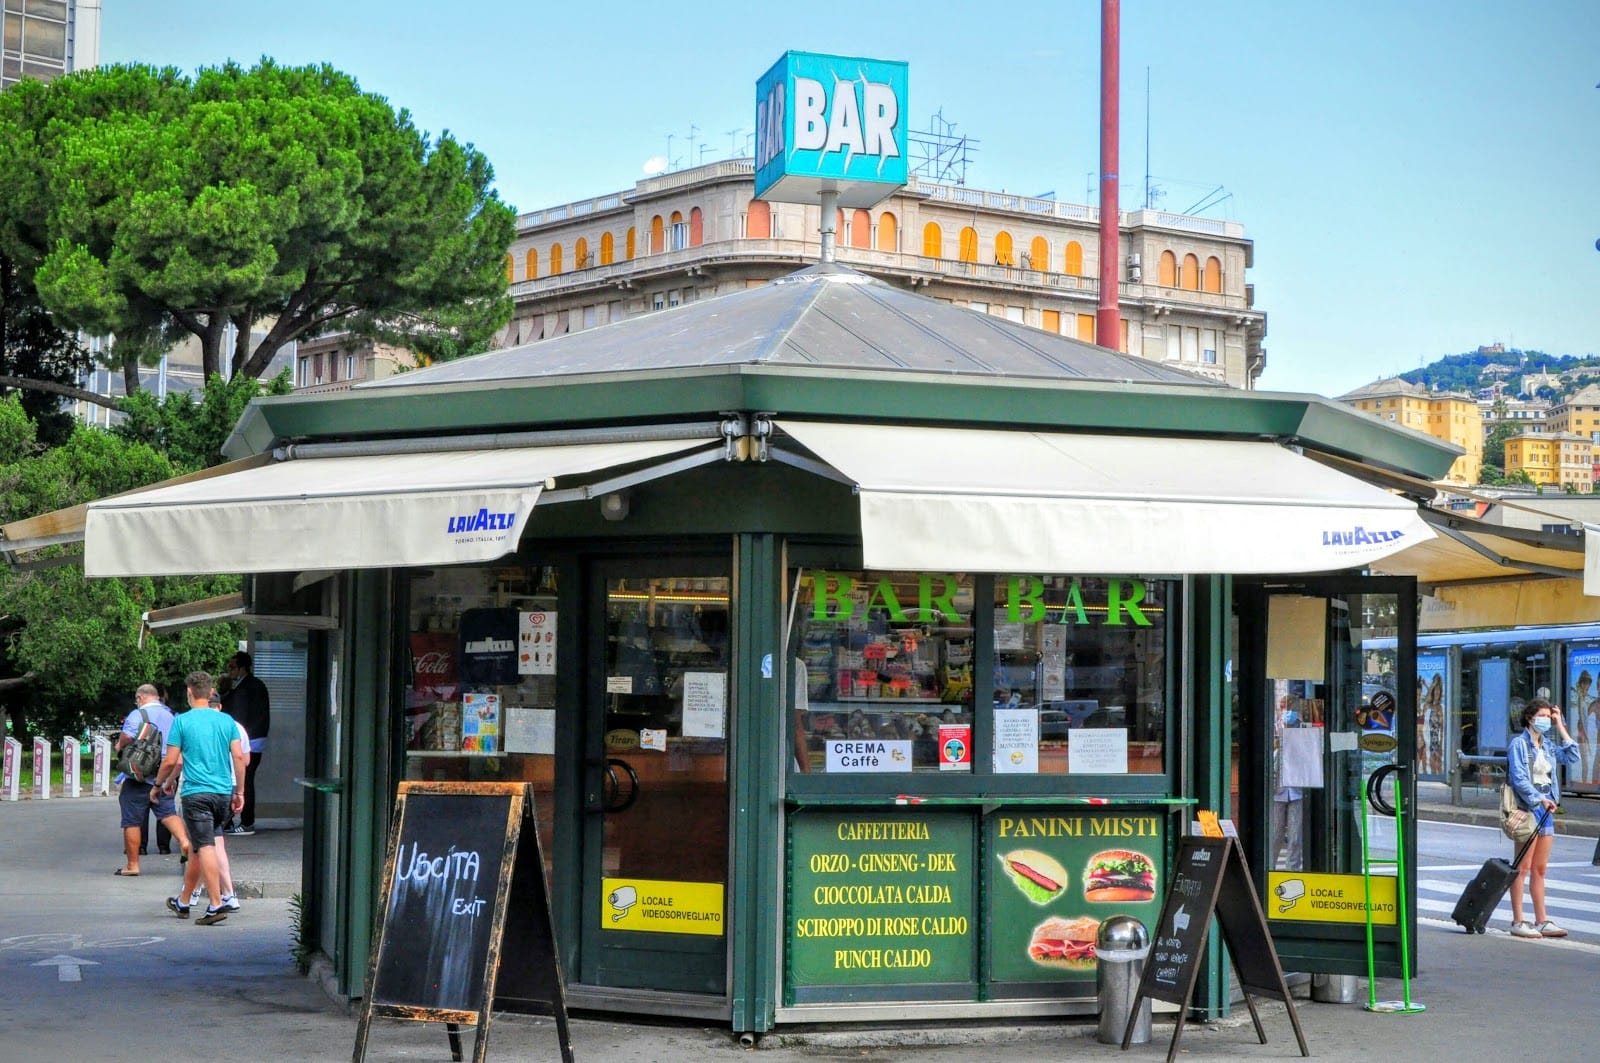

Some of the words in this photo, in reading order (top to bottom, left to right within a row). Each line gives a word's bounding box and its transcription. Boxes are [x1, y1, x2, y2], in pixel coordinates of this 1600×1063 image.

[757, 82, 785, 171] BAR
[795, 77, 899, 157] BAR
[447, 508, 515, 533] LAVAZZA
[1322, 526, 1405, 546] LAVAZZA
[812, 572, 965, 623] BAR
[1007, 576, 1153, 626] BAR
[834, 743, 886, 754] CREMA
[841, 755, 879, 767] Caffè
[838, 822, 930, 840] CAFFETTERIA
[998, 818, 1084, 837] PANINI
[1089, 818, 1158, 837] MISTI
[810, 854, 850, 873] ORZO
[859, 853, 918, 872] GINSENG
[927, 853, 956, 872] DEK
[642, 896, 673, 906] LOCALE
[814, 886, 903, 905] CIOCCOLATA
[906, 885, 951, 904] CALDA
[1310, 888, 1343, 898] LOCALE
[642, 909, 720, 922] VIDEOSORVEGLIATO
[797, 918, 864, 937] SCIROPPO
[867, 918, 881, 936] DI
[884, 917, 919, 936] ROSE
[922, 916, 967, 936] CALDO
[834, 950, 881, 969] PUNCH
[884, 949, 931, 968] CALDO
